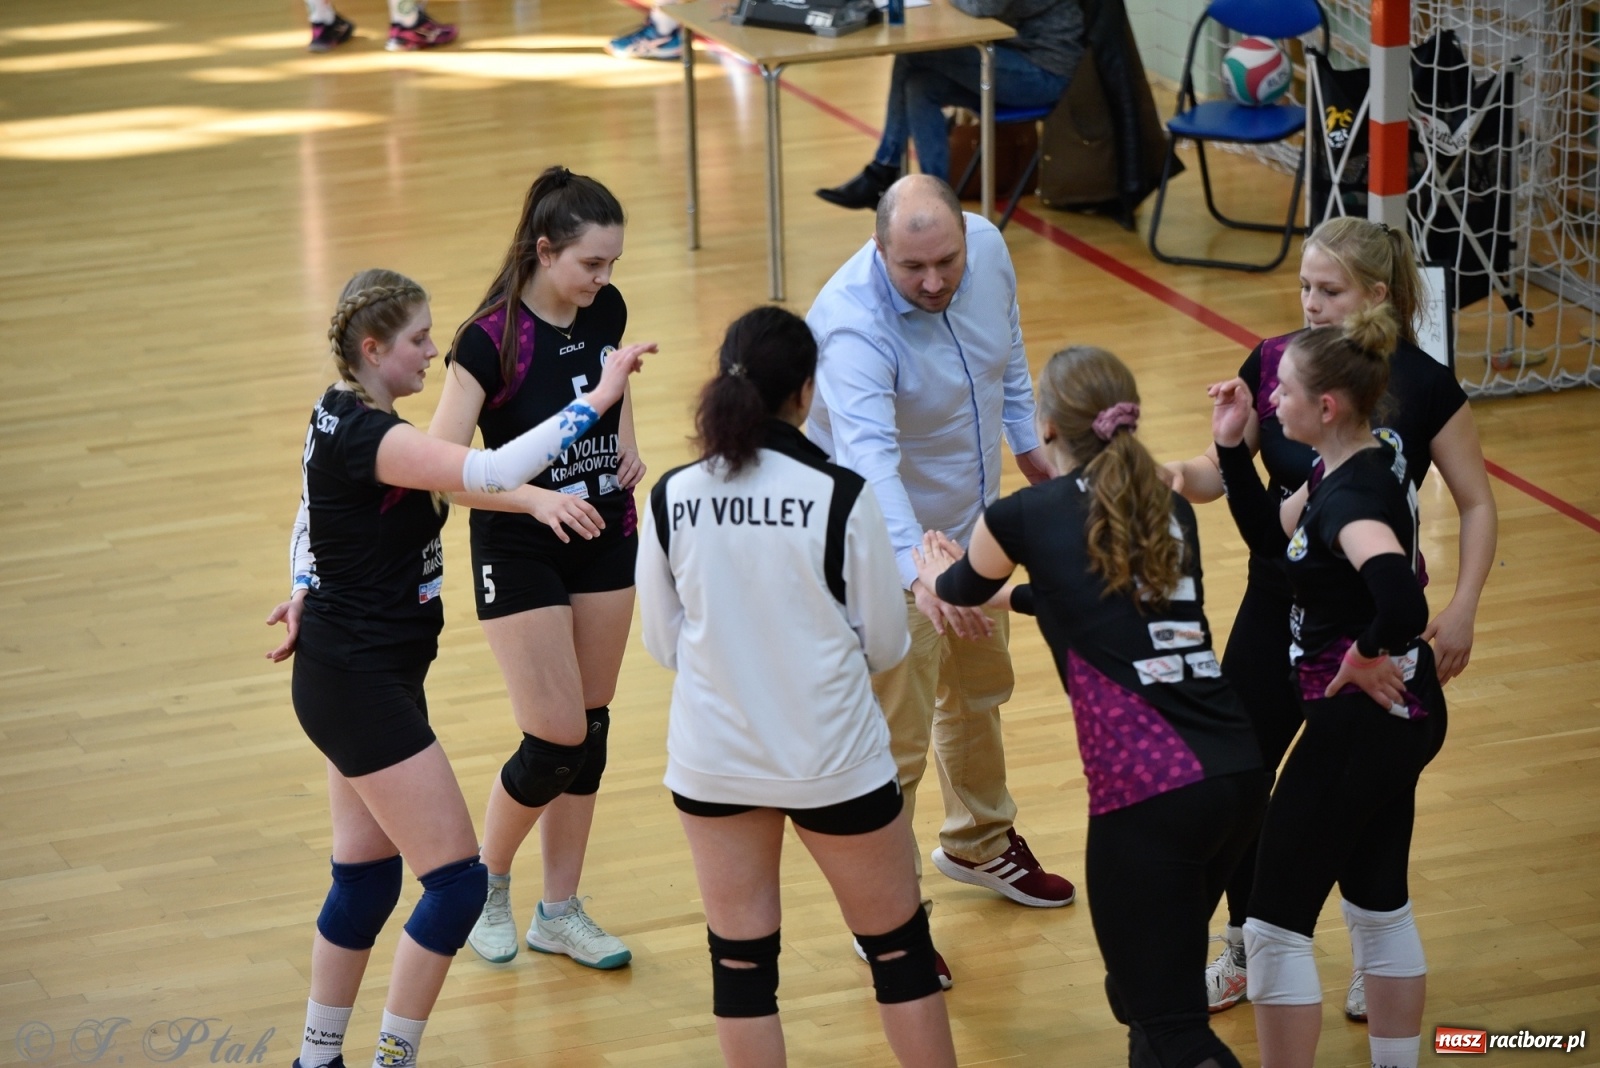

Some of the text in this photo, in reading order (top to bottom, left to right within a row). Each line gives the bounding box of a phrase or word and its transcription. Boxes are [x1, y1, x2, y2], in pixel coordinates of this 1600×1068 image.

[559, 341, 585, 356] COLO
[673, 496, 815, 531] PV VOLLEY
[482, 564, 496, 604] 5
